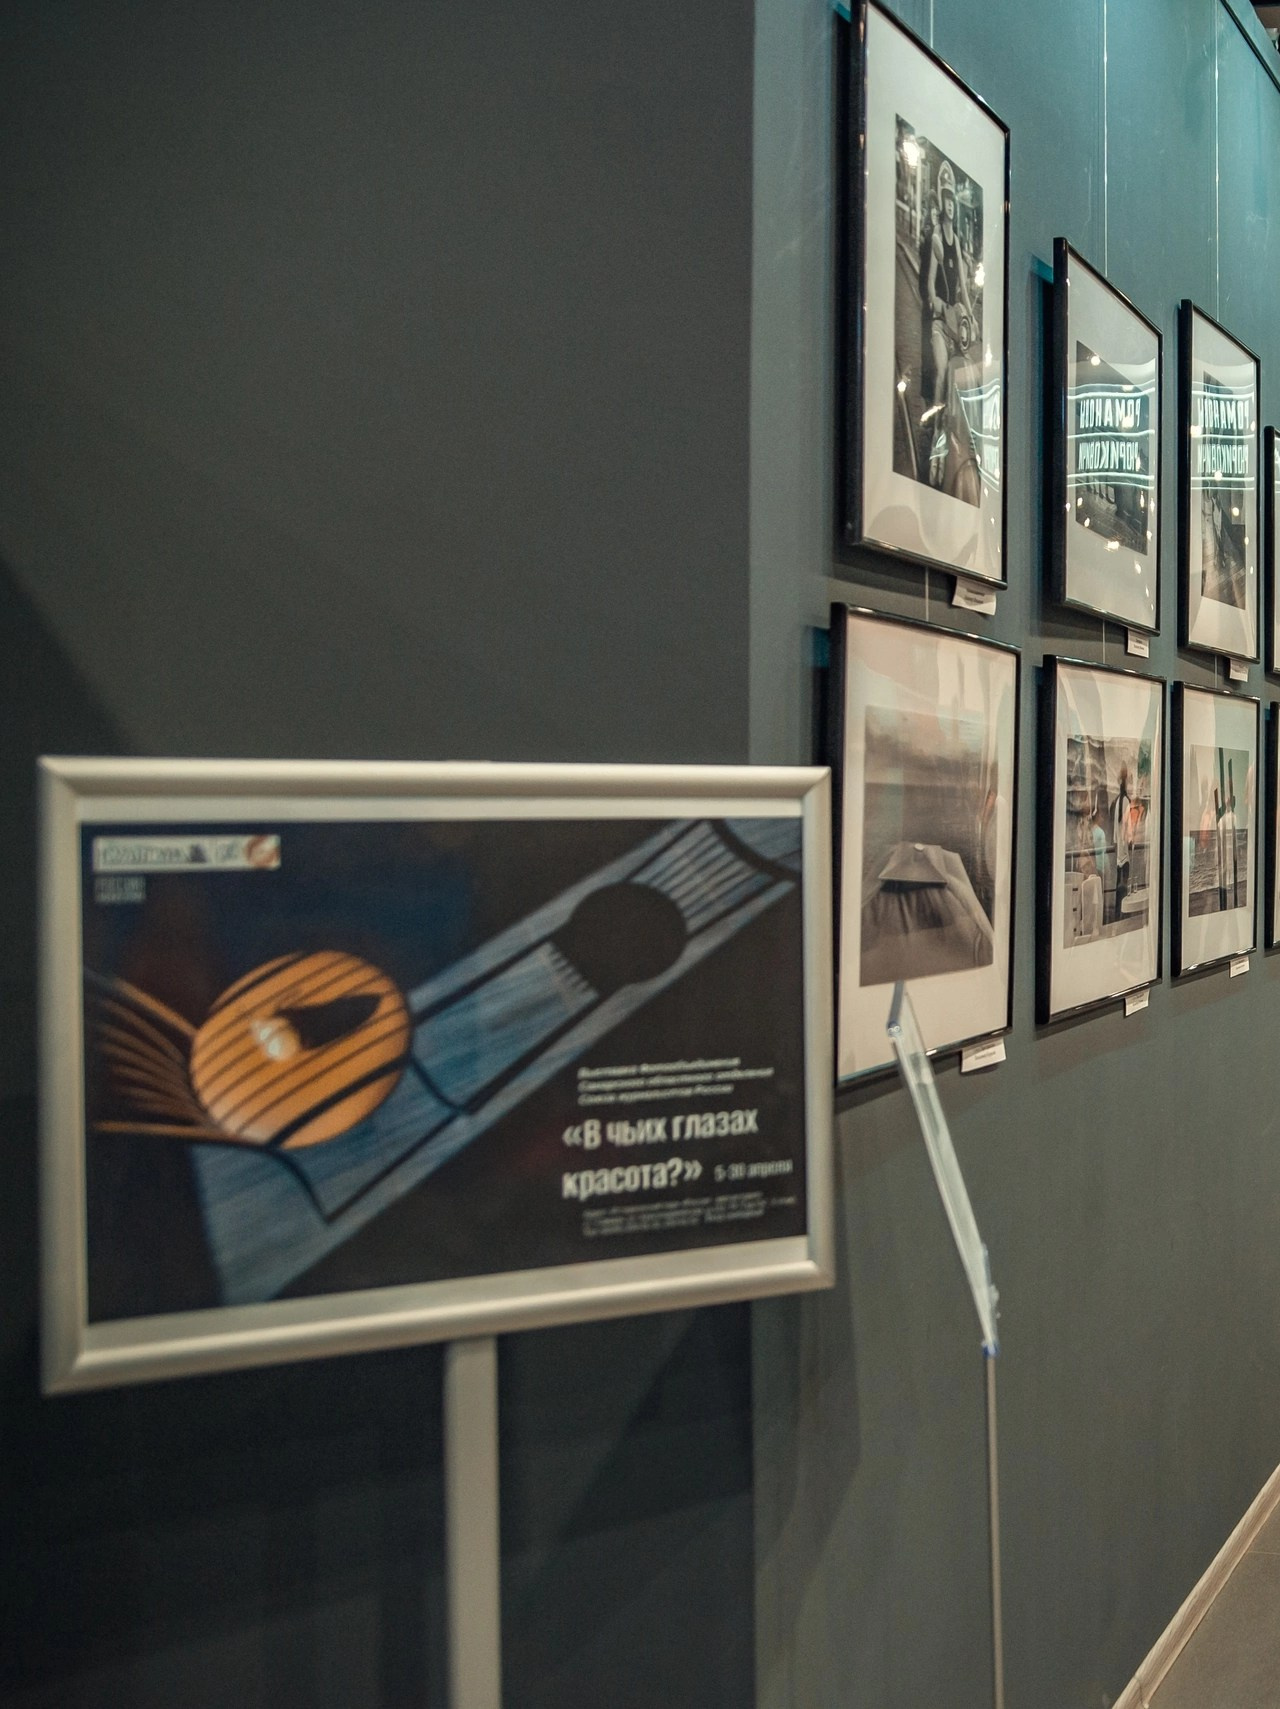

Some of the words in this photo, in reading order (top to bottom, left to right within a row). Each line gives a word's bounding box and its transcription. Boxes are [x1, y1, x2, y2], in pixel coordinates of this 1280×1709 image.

[562, 1118, 601, 1150] «В
[606, 1116, 668, 1147] чьих
[671, 1108, 760, 1141] глазах
[561, 1156, 703, 1201] красота?»
